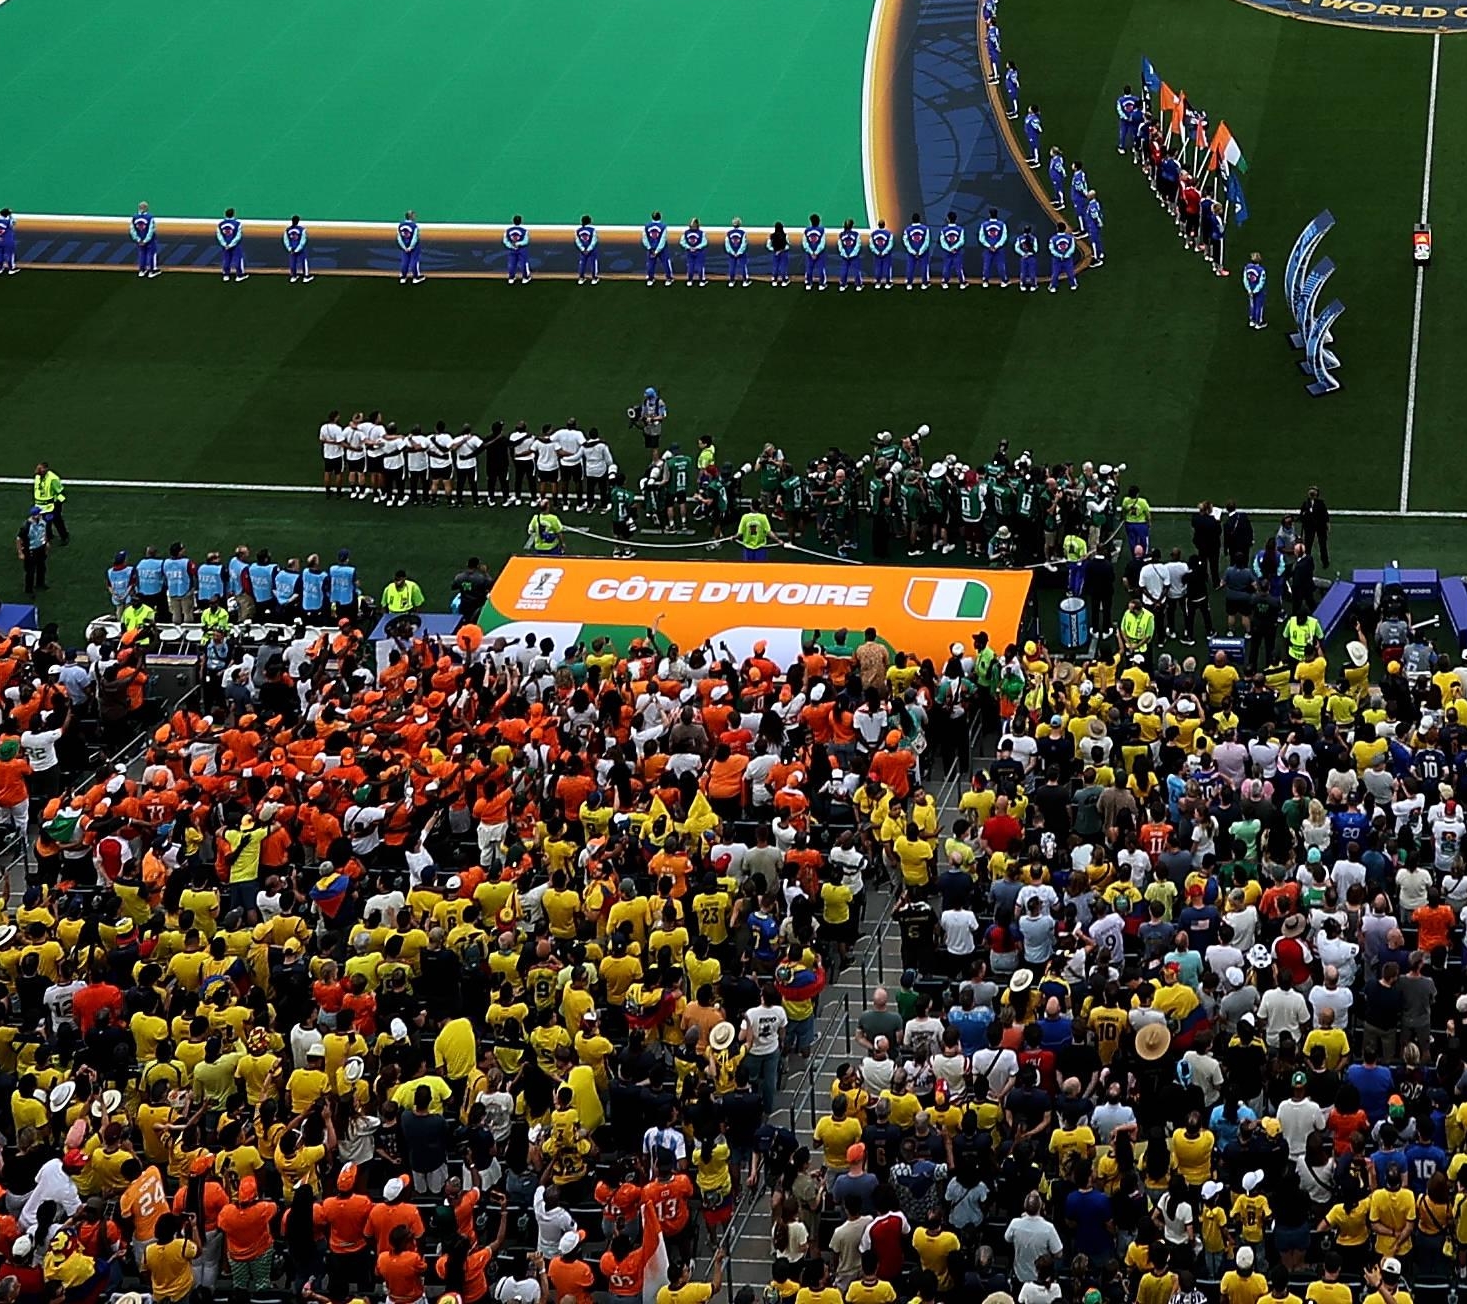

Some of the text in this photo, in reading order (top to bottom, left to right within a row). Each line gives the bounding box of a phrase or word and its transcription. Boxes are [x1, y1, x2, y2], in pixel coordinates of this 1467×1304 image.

[588, 576, 872, 607] CÔTE D'IVOIRE
[1424, 762, 1437, 778] 10
[1343, 827, 1360, 838] 20
[1151, 838, 1163, 853] 11
[702, 908, 718, 923] 23
[1105, 934, 1116, 948] 9
[536, 981, 547, 996] 9
[1098, 1023, 1115, 1040] 10
[1414, 1159, 1436, 1178] 10
[138, 1184, 166, 1216] 24
[655, 1199, 678, 1223] 13
